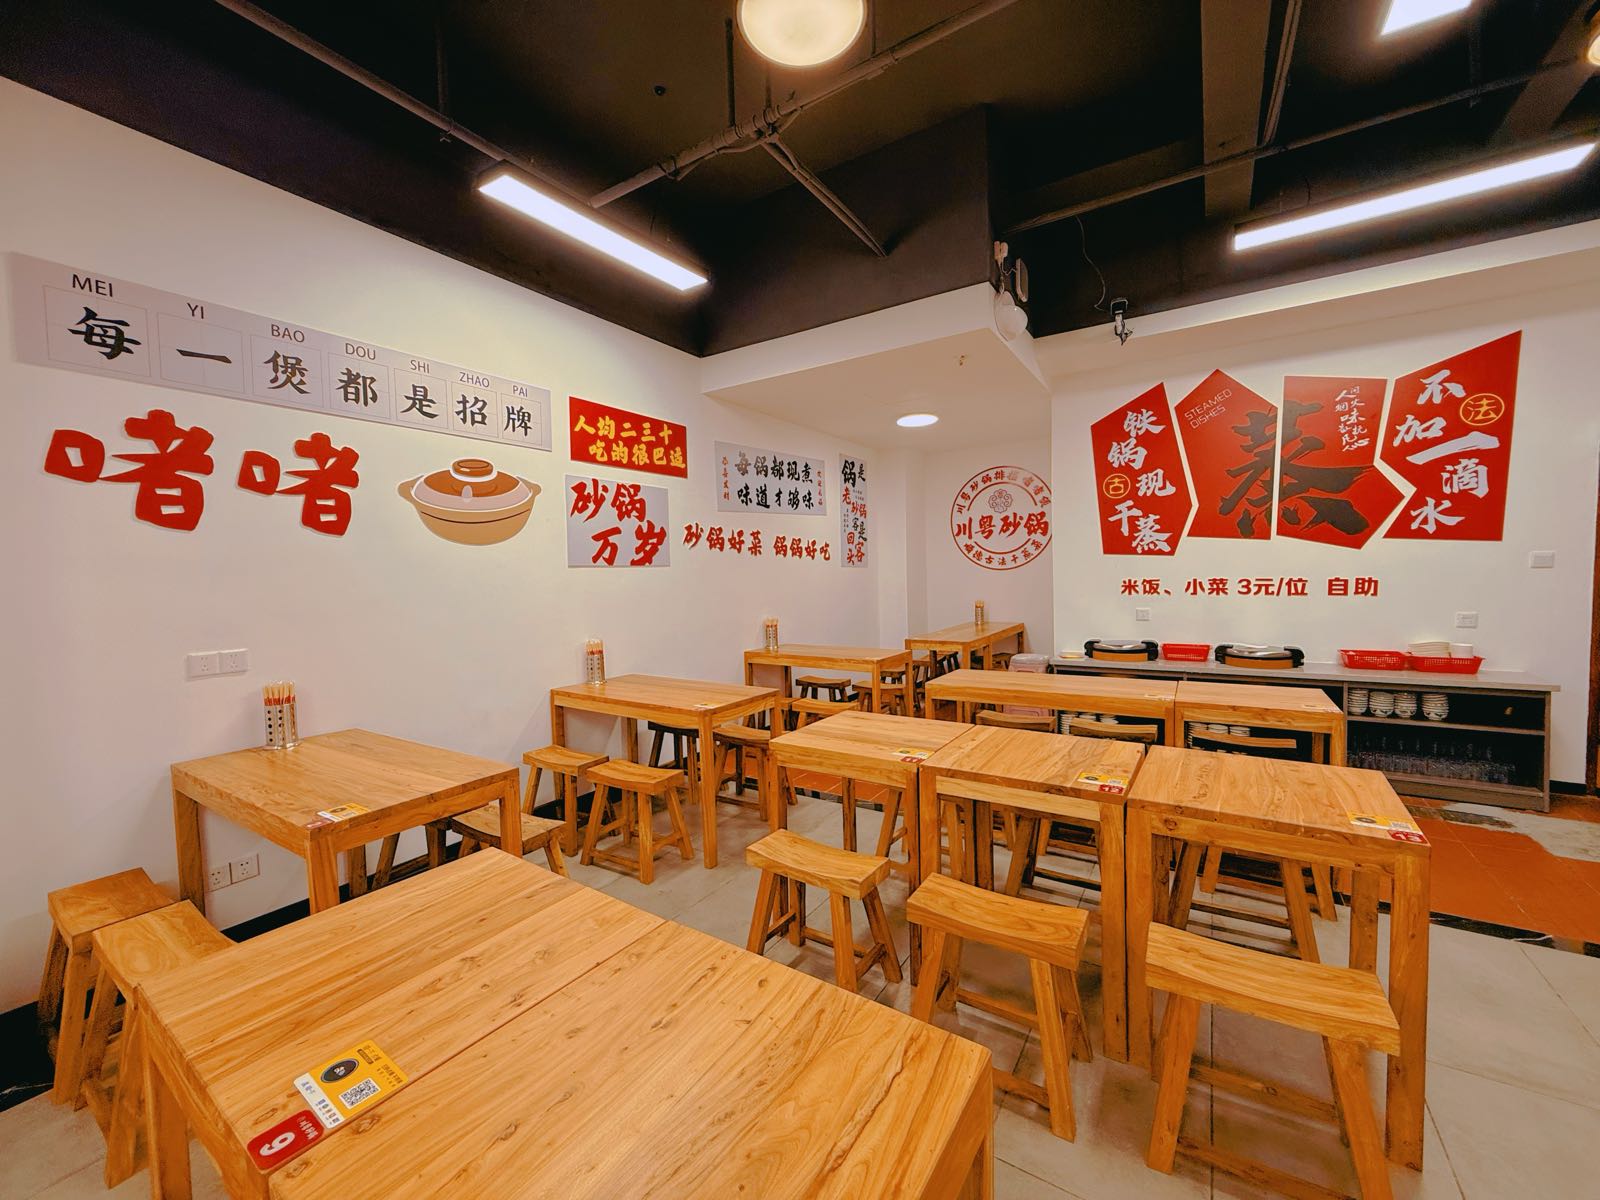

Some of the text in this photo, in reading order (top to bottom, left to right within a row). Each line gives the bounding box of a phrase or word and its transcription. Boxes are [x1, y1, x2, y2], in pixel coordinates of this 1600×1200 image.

[71, 274, 528, 397] MEI YI BAO DOU SHI ZHAO PAI
[1184, 388, 1233, 421] STEAMED
[1189, 404, 1226, 429] DISHES
[1467, 397, 1497, 422] 法
[574, 415, 672, 445] 人均二三十
[735, 451, 813, 484] 每锅都现煮
[570, 478, 646, 523] 砂锅
[737, 482, 814, 511] 味道才够味
[956, 511, 1049, 540] 川粤砂锅
[592, 520, 667, 566] 万岁
[683, 523, 831, 561] 砂锅好菜 锅锅好吃
[1121, 577, 1379, 597] 米饭、小菜 3元/位 自助
